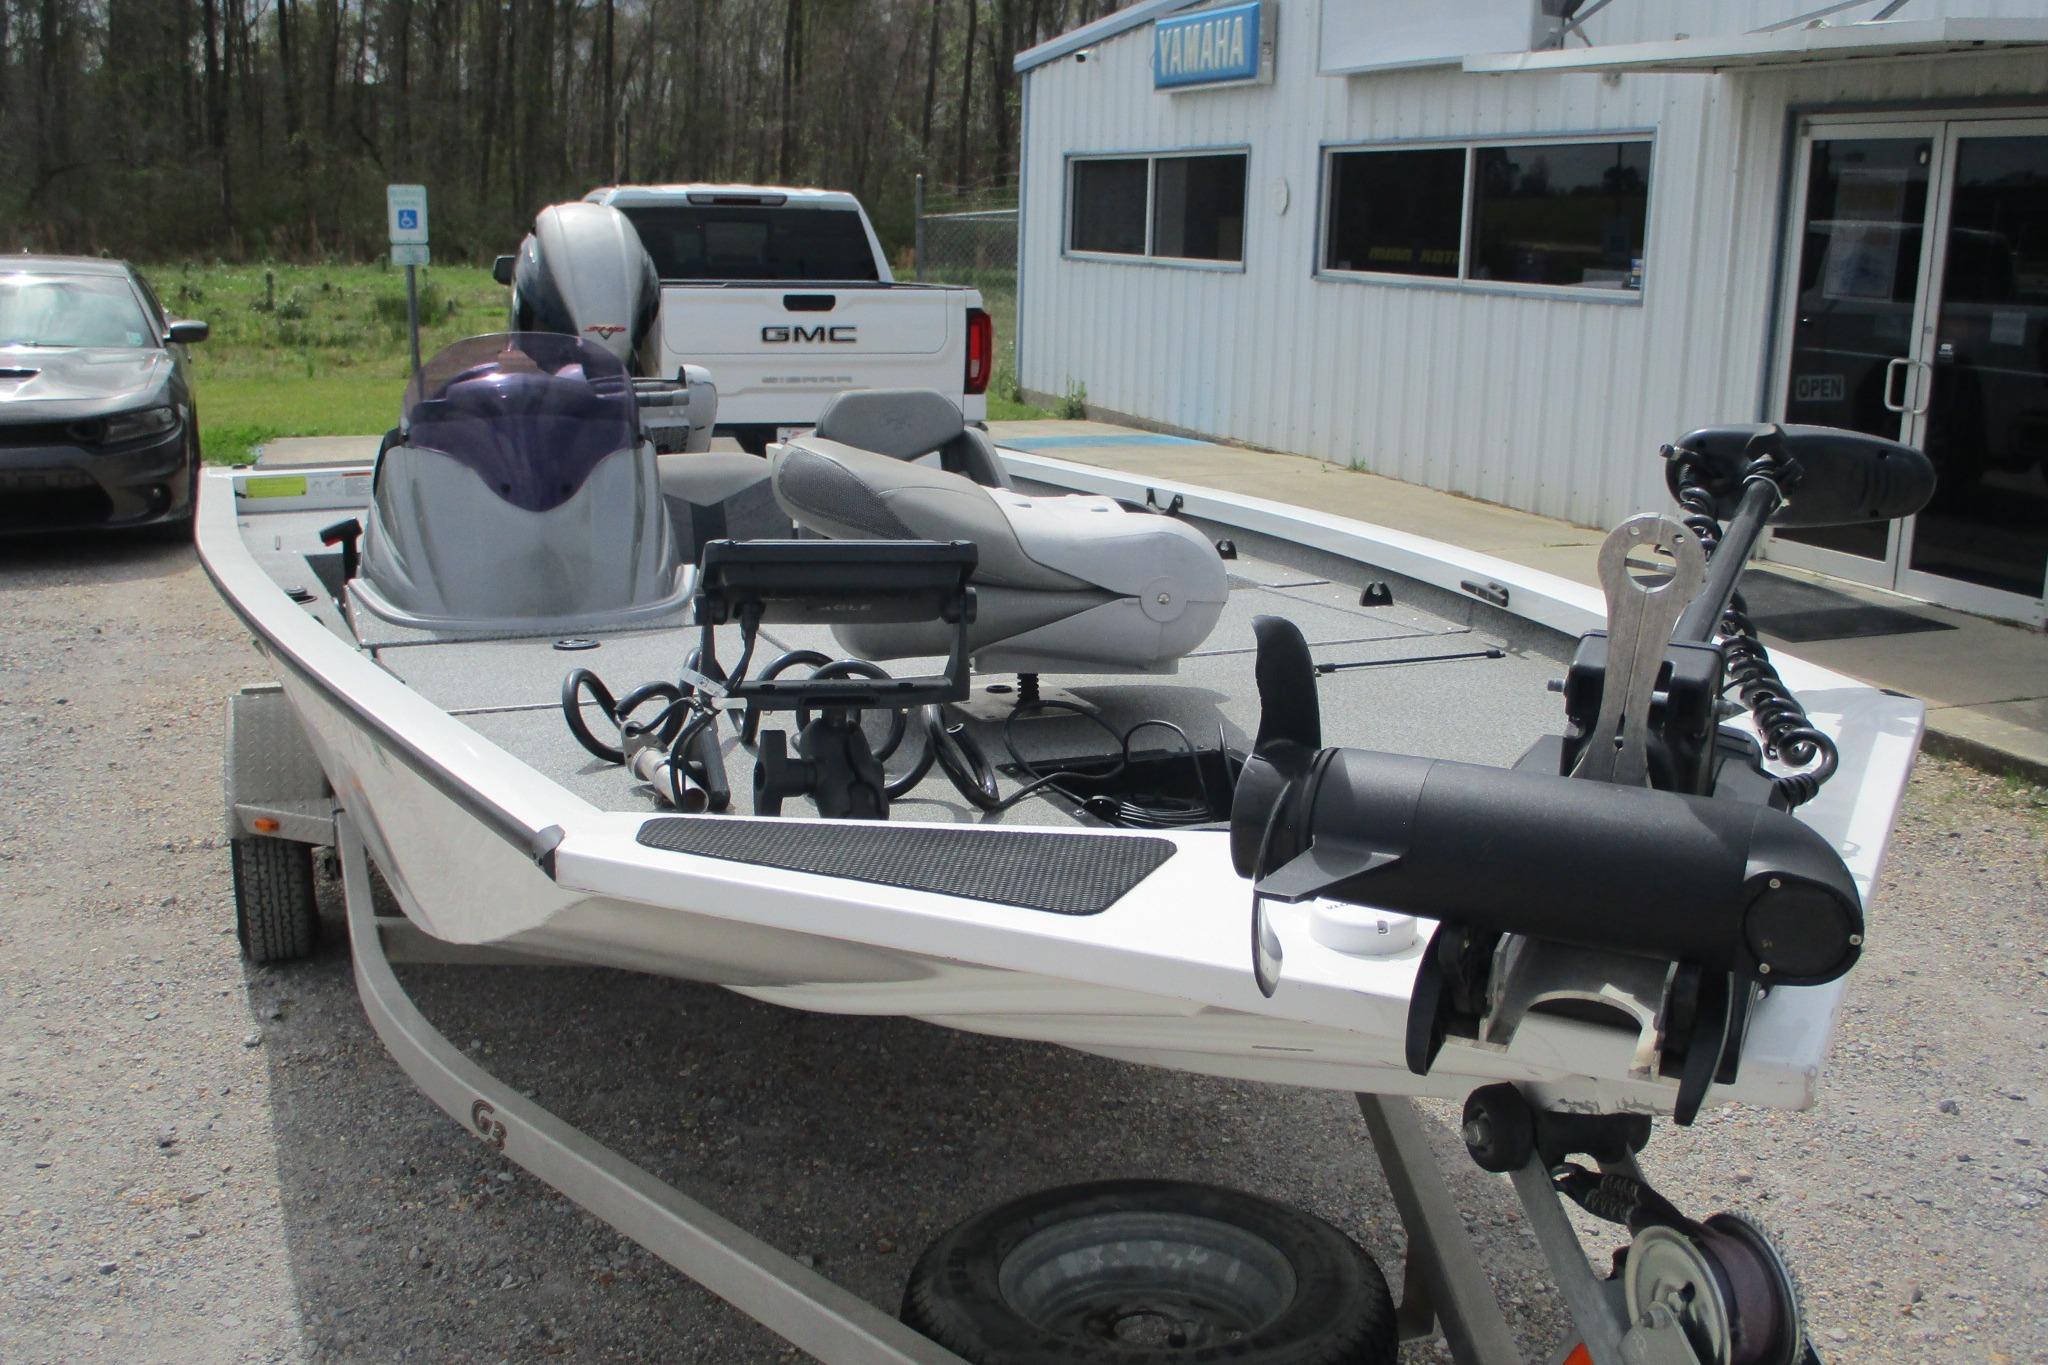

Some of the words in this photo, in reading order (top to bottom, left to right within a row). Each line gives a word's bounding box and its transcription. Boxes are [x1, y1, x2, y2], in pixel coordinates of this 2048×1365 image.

[1159, 17, 1244, 76] YAMAHA
[761, 325, 857, 343] GMC
[1798, 379, 1842, 398] OPEN
[471, 1098, 508, 1151] G3
